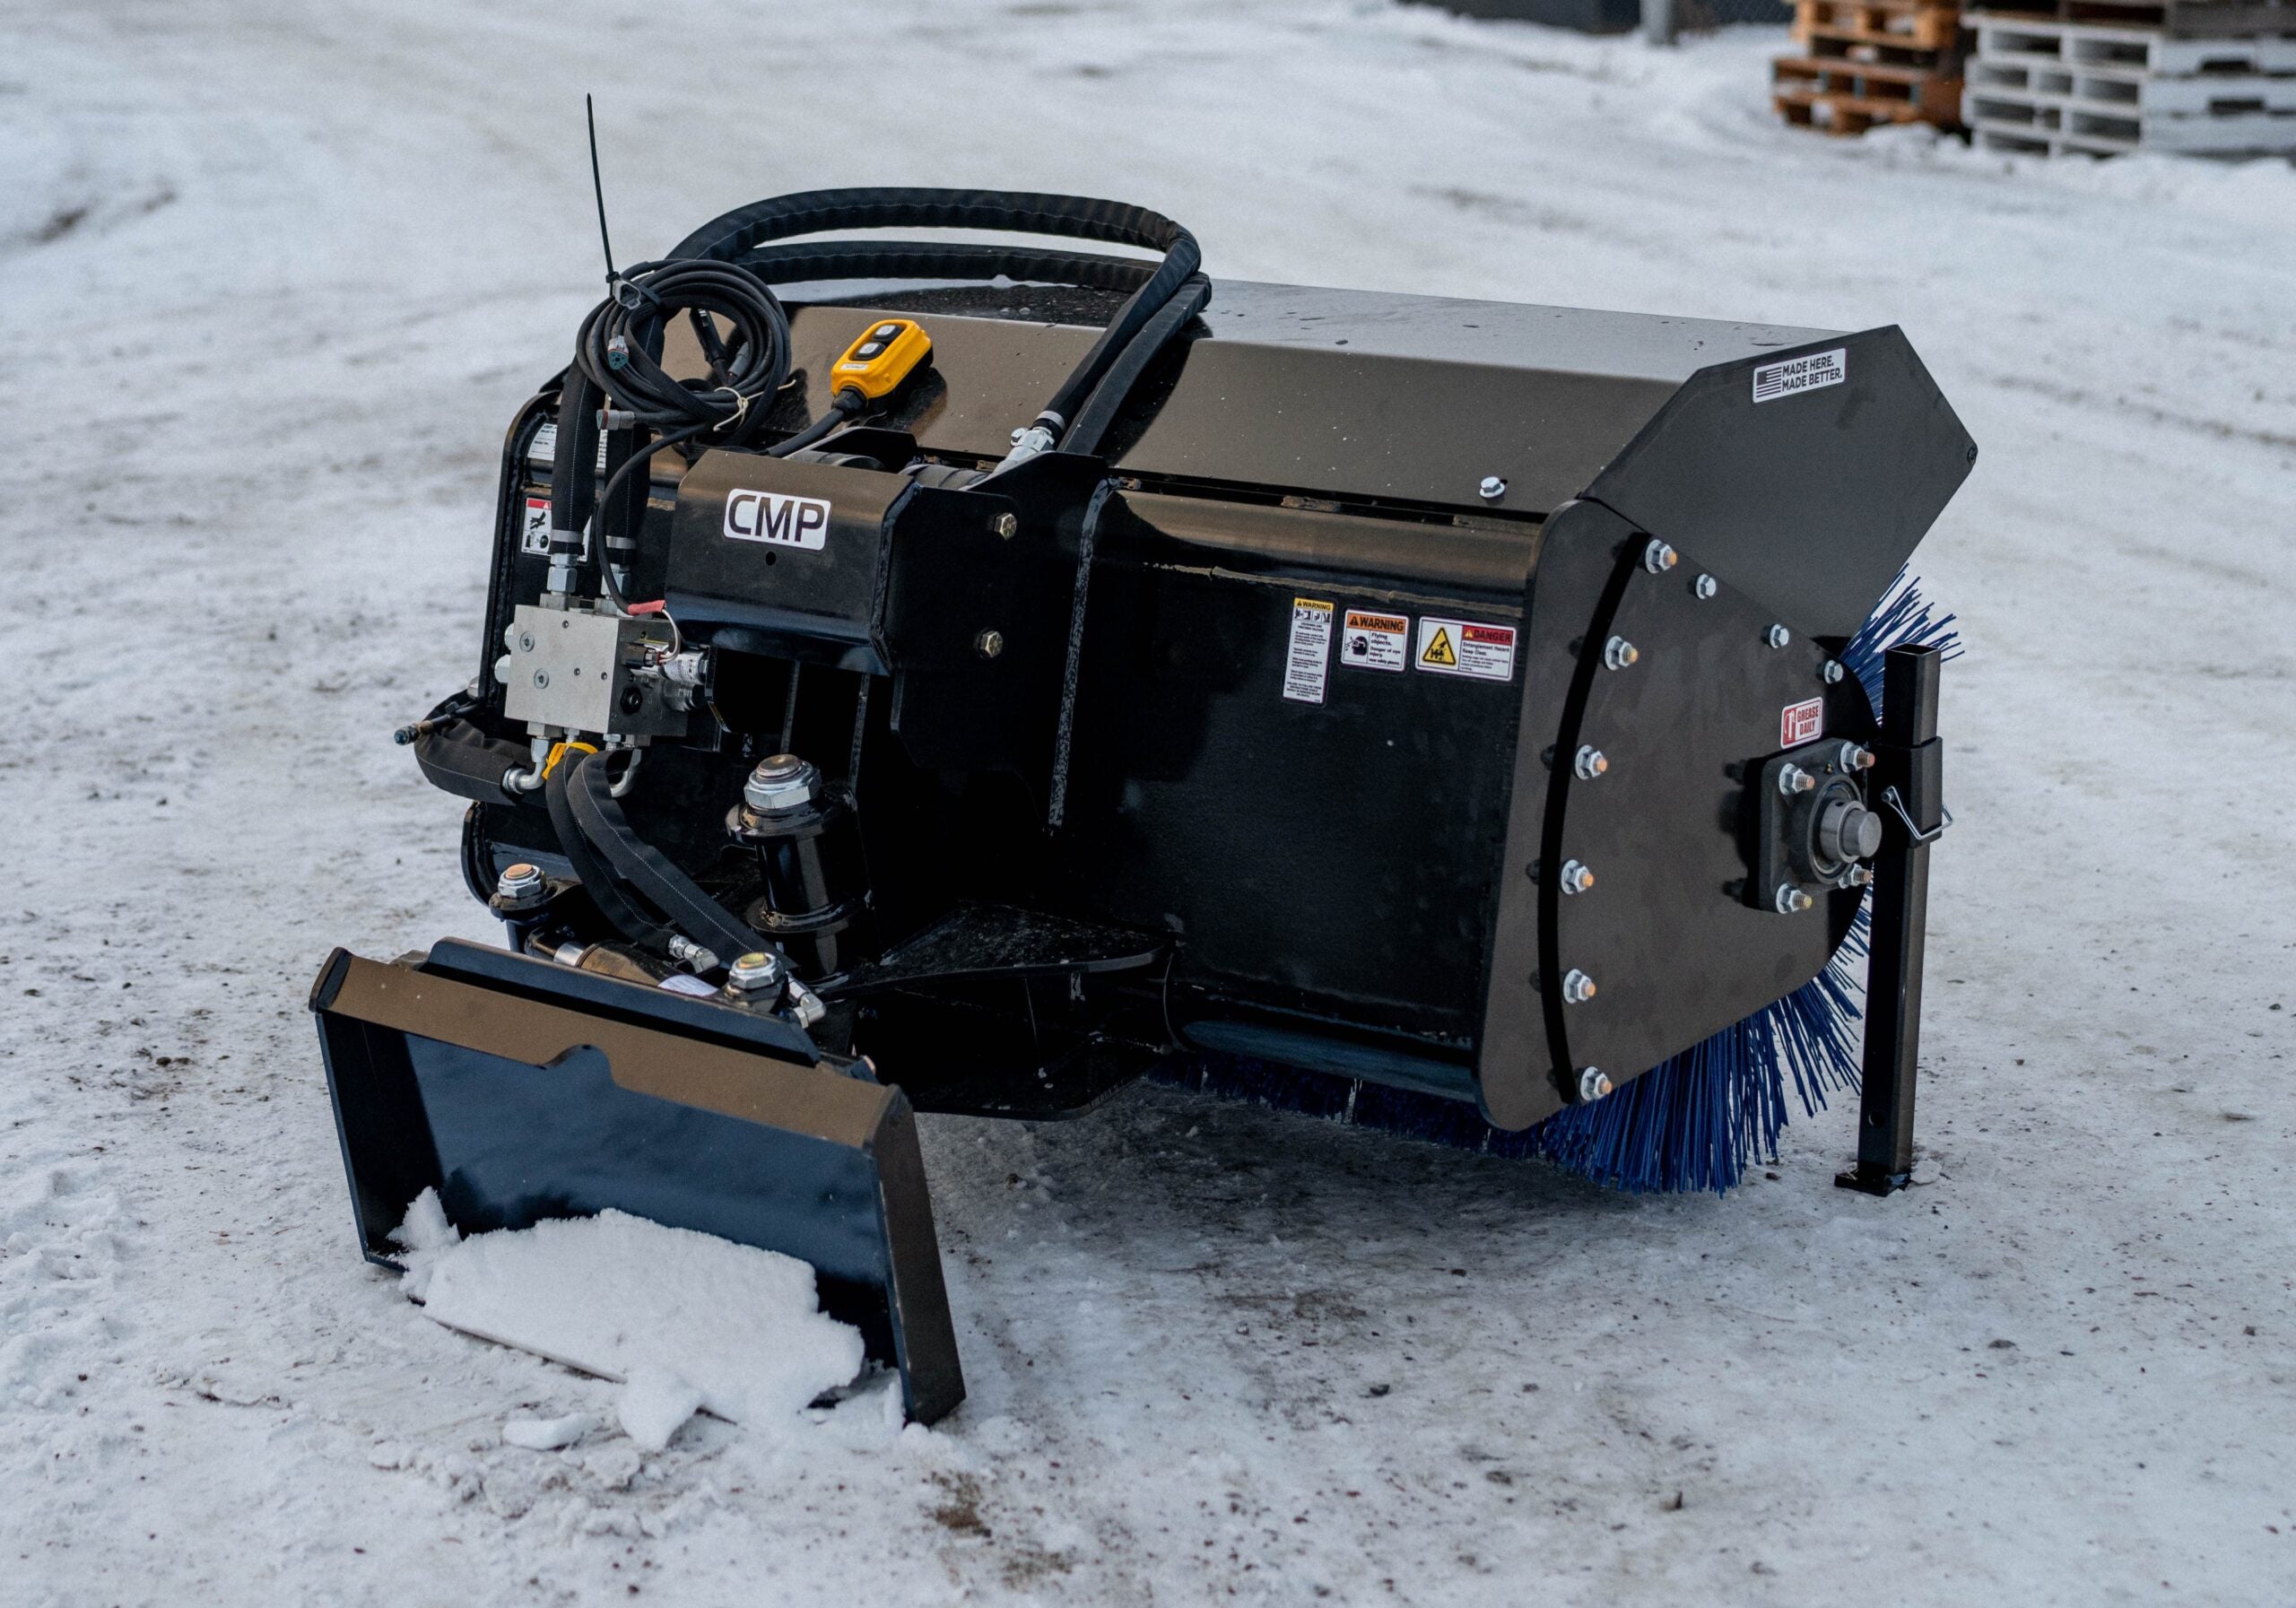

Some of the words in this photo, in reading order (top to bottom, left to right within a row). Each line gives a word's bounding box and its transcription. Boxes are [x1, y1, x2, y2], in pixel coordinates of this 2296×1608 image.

[1782, 361, 1808, 377] MADE
[1809, 355, 1834, 371] HERE.
[1781, 375, 1807, 392] MADE
[1808, 367, 1842, 386] BETTER.
[728, 494, 825, 543] CMP
[1302, 601, 1331, 611] WARNING
[1360, 616, 1404, 631] WARNING
[1371, 632, 1387, 640] Flying
[1474, 630, 1510, 641] DANGER
[1797, 706, 1818, 722] GREASE
[1800, 719, 1815, 735] DAILY
